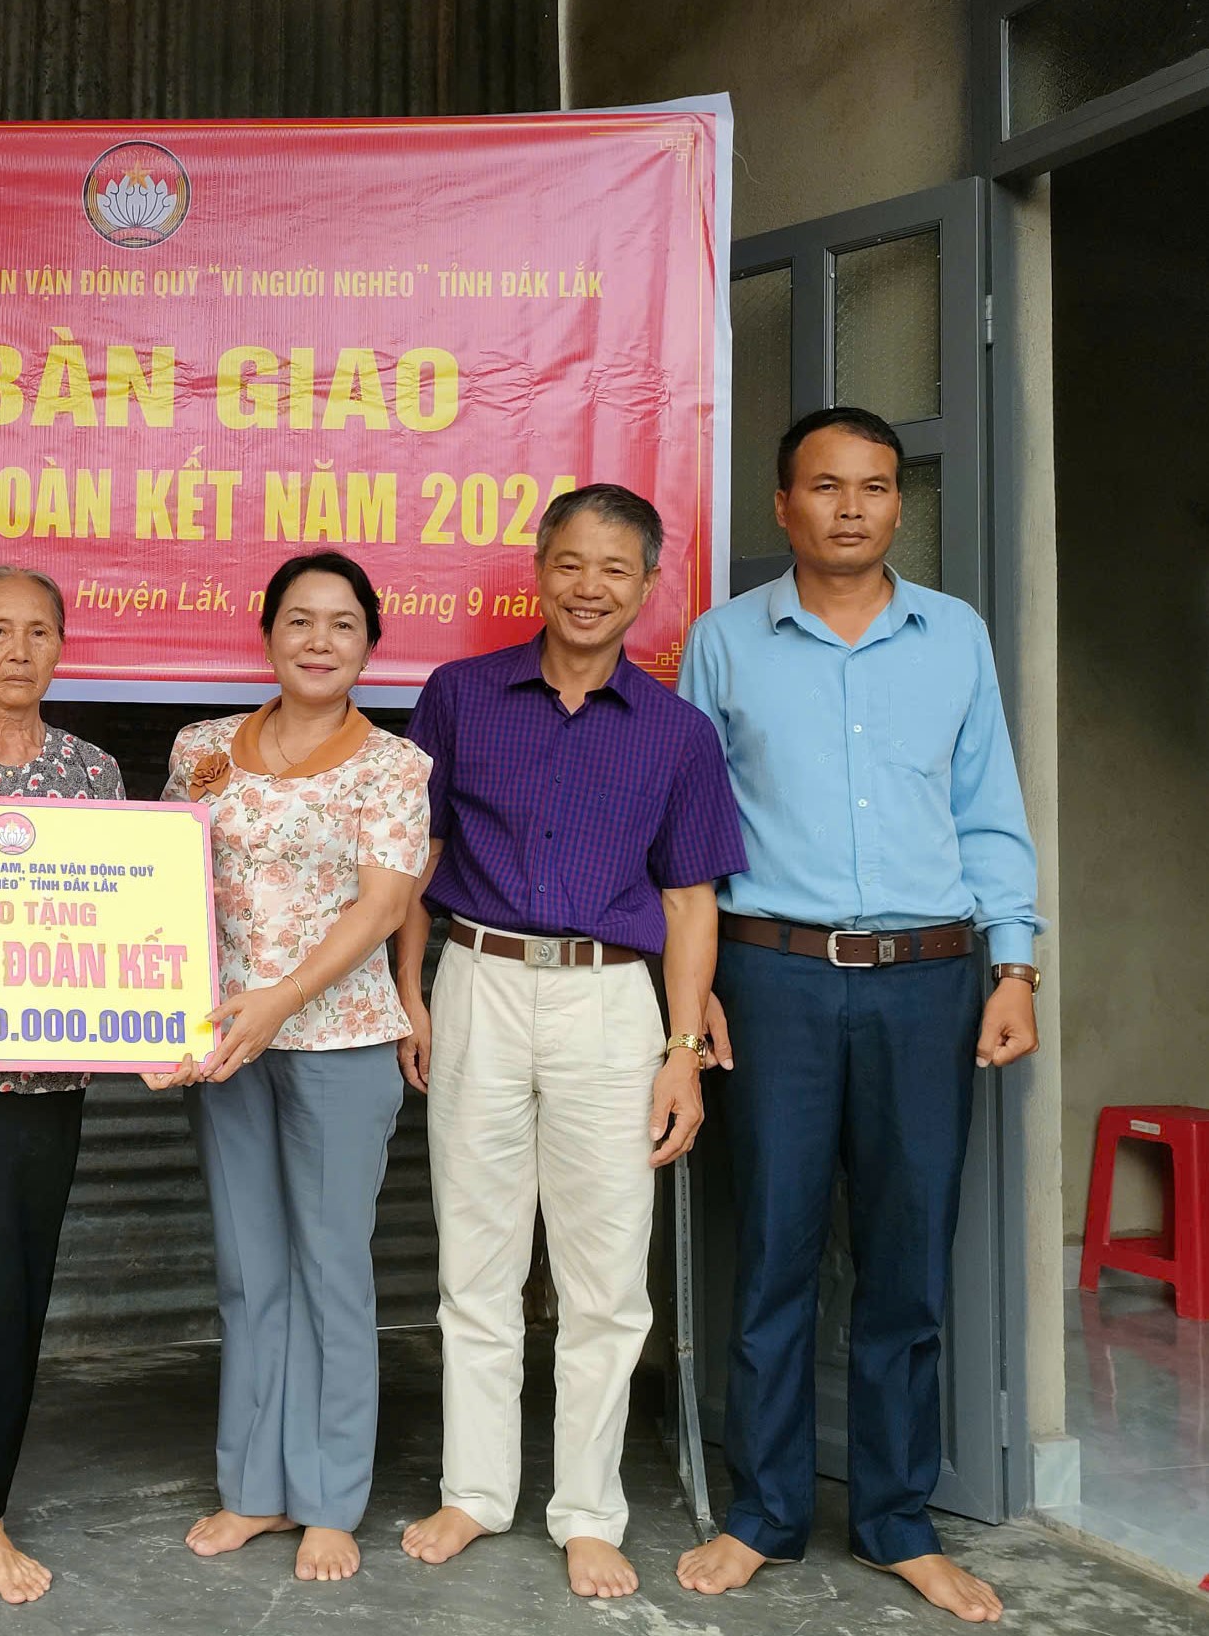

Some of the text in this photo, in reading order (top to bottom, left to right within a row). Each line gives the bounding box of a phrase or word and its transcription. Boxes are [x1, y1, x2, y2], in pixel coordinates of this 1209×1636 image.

[26, 264, 72, 300] VẬN
[81, 264, 144, 301] ĐỘNG
[154, 265, 198, 298] QUỸ
[252, 264, 324, 297] NGƯỜI
[438, 262, 492, 297] TỈNH
[499, 261, 550, 297] ĐẮK
[558, 261, 603, 298] LẮK
[216, 346, 459, 431] GIAO
[135, 445, 242, 541] KẾT
[263, 459, 397, 543] NĂM
[75, 580, 167, 617] Huyện
[177, 575, 236, 617] Lắk,
[467, 587, 483, 617] 9
[29, 863, 56, 874] BAN
[60, 863, 86, 877] VẬN
[90, 863, 126, 878] ĐỘNG
[129, 865, 154, 877] QUỸ
[30, 877, 59, 891] TỈNH
[63, 877, 89, 892] ĐẮK
[93, 878, 118, 892] LẮK
[23, 897, 96, 930] TẶNG
[2, 933, 106, 988] ĐOÀN
[117, 927, 188, 989] KẾT
